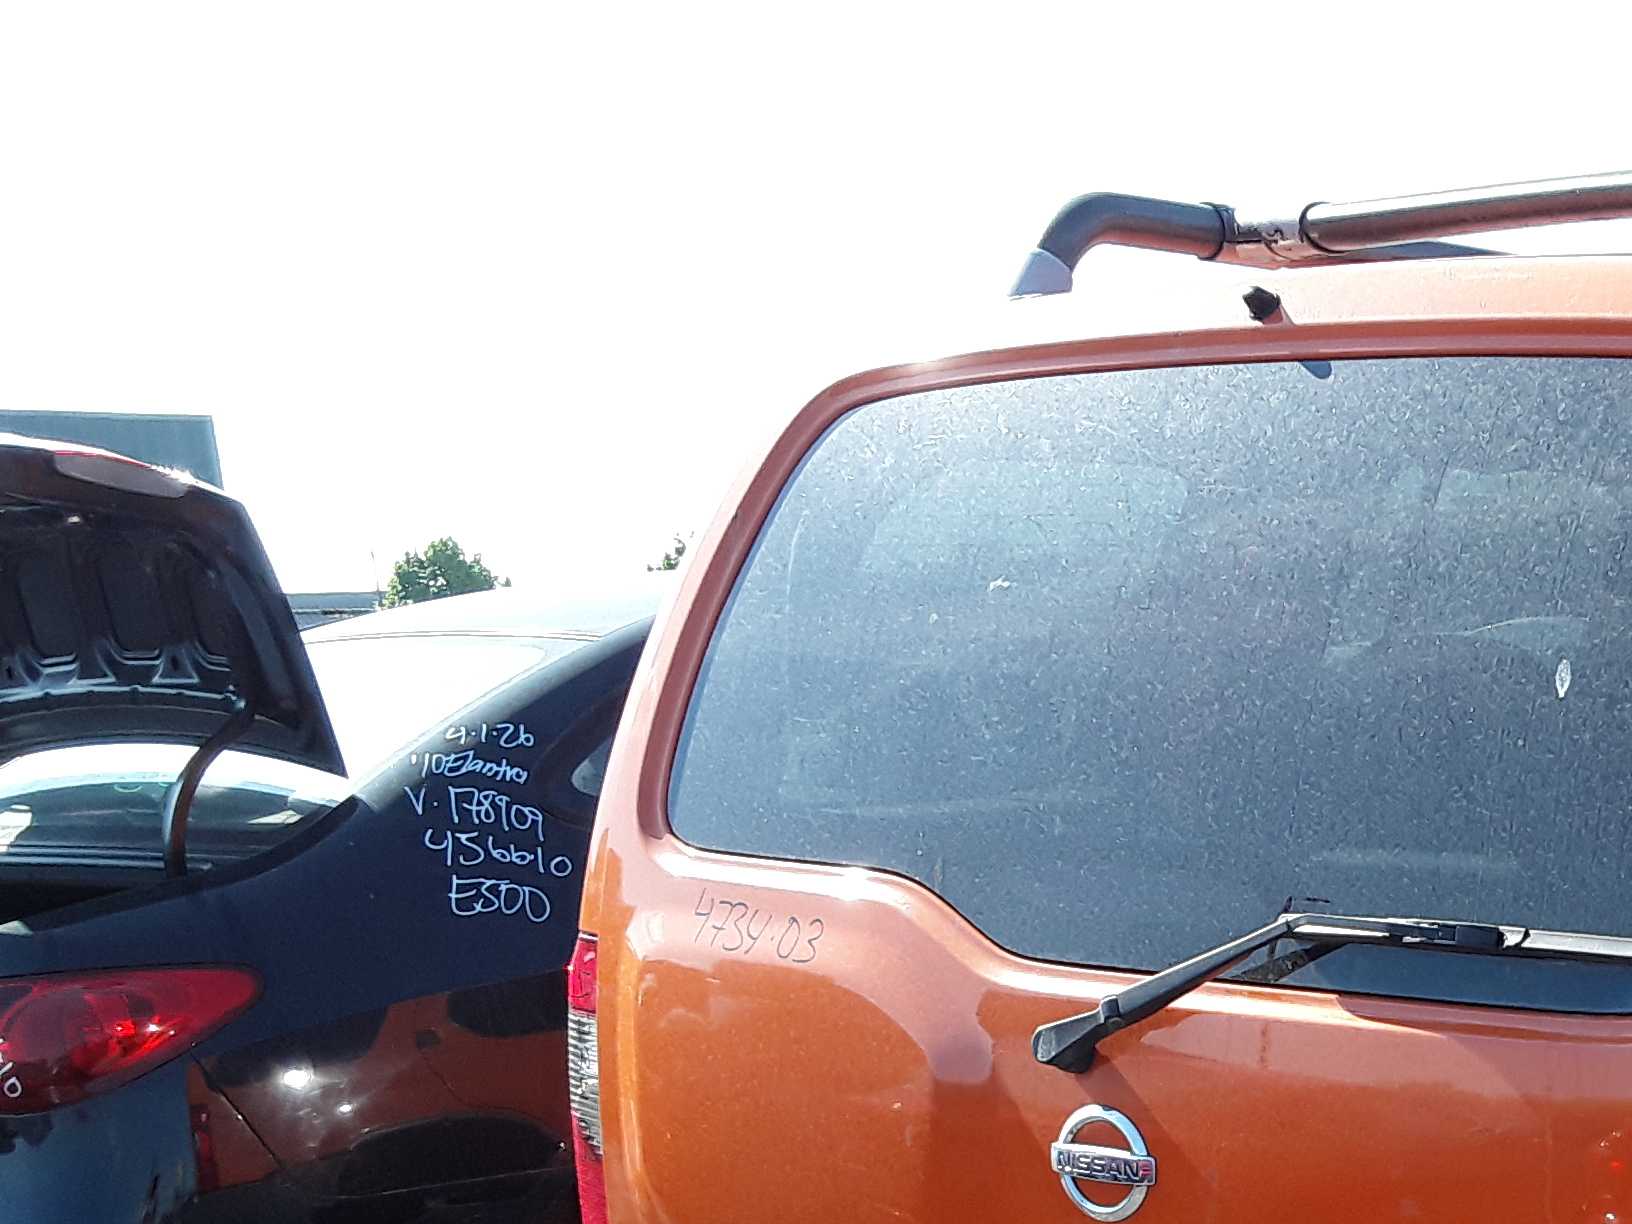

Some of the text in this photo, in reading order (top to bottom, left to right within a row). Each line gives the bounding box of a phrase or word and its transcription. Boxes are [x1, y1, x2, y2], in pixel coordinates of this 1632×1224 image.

[448, 785, 545, 842] 178909
[448, 874, 551, 923] E500
[1057, 1149, 1141, 1180] NISSAN
